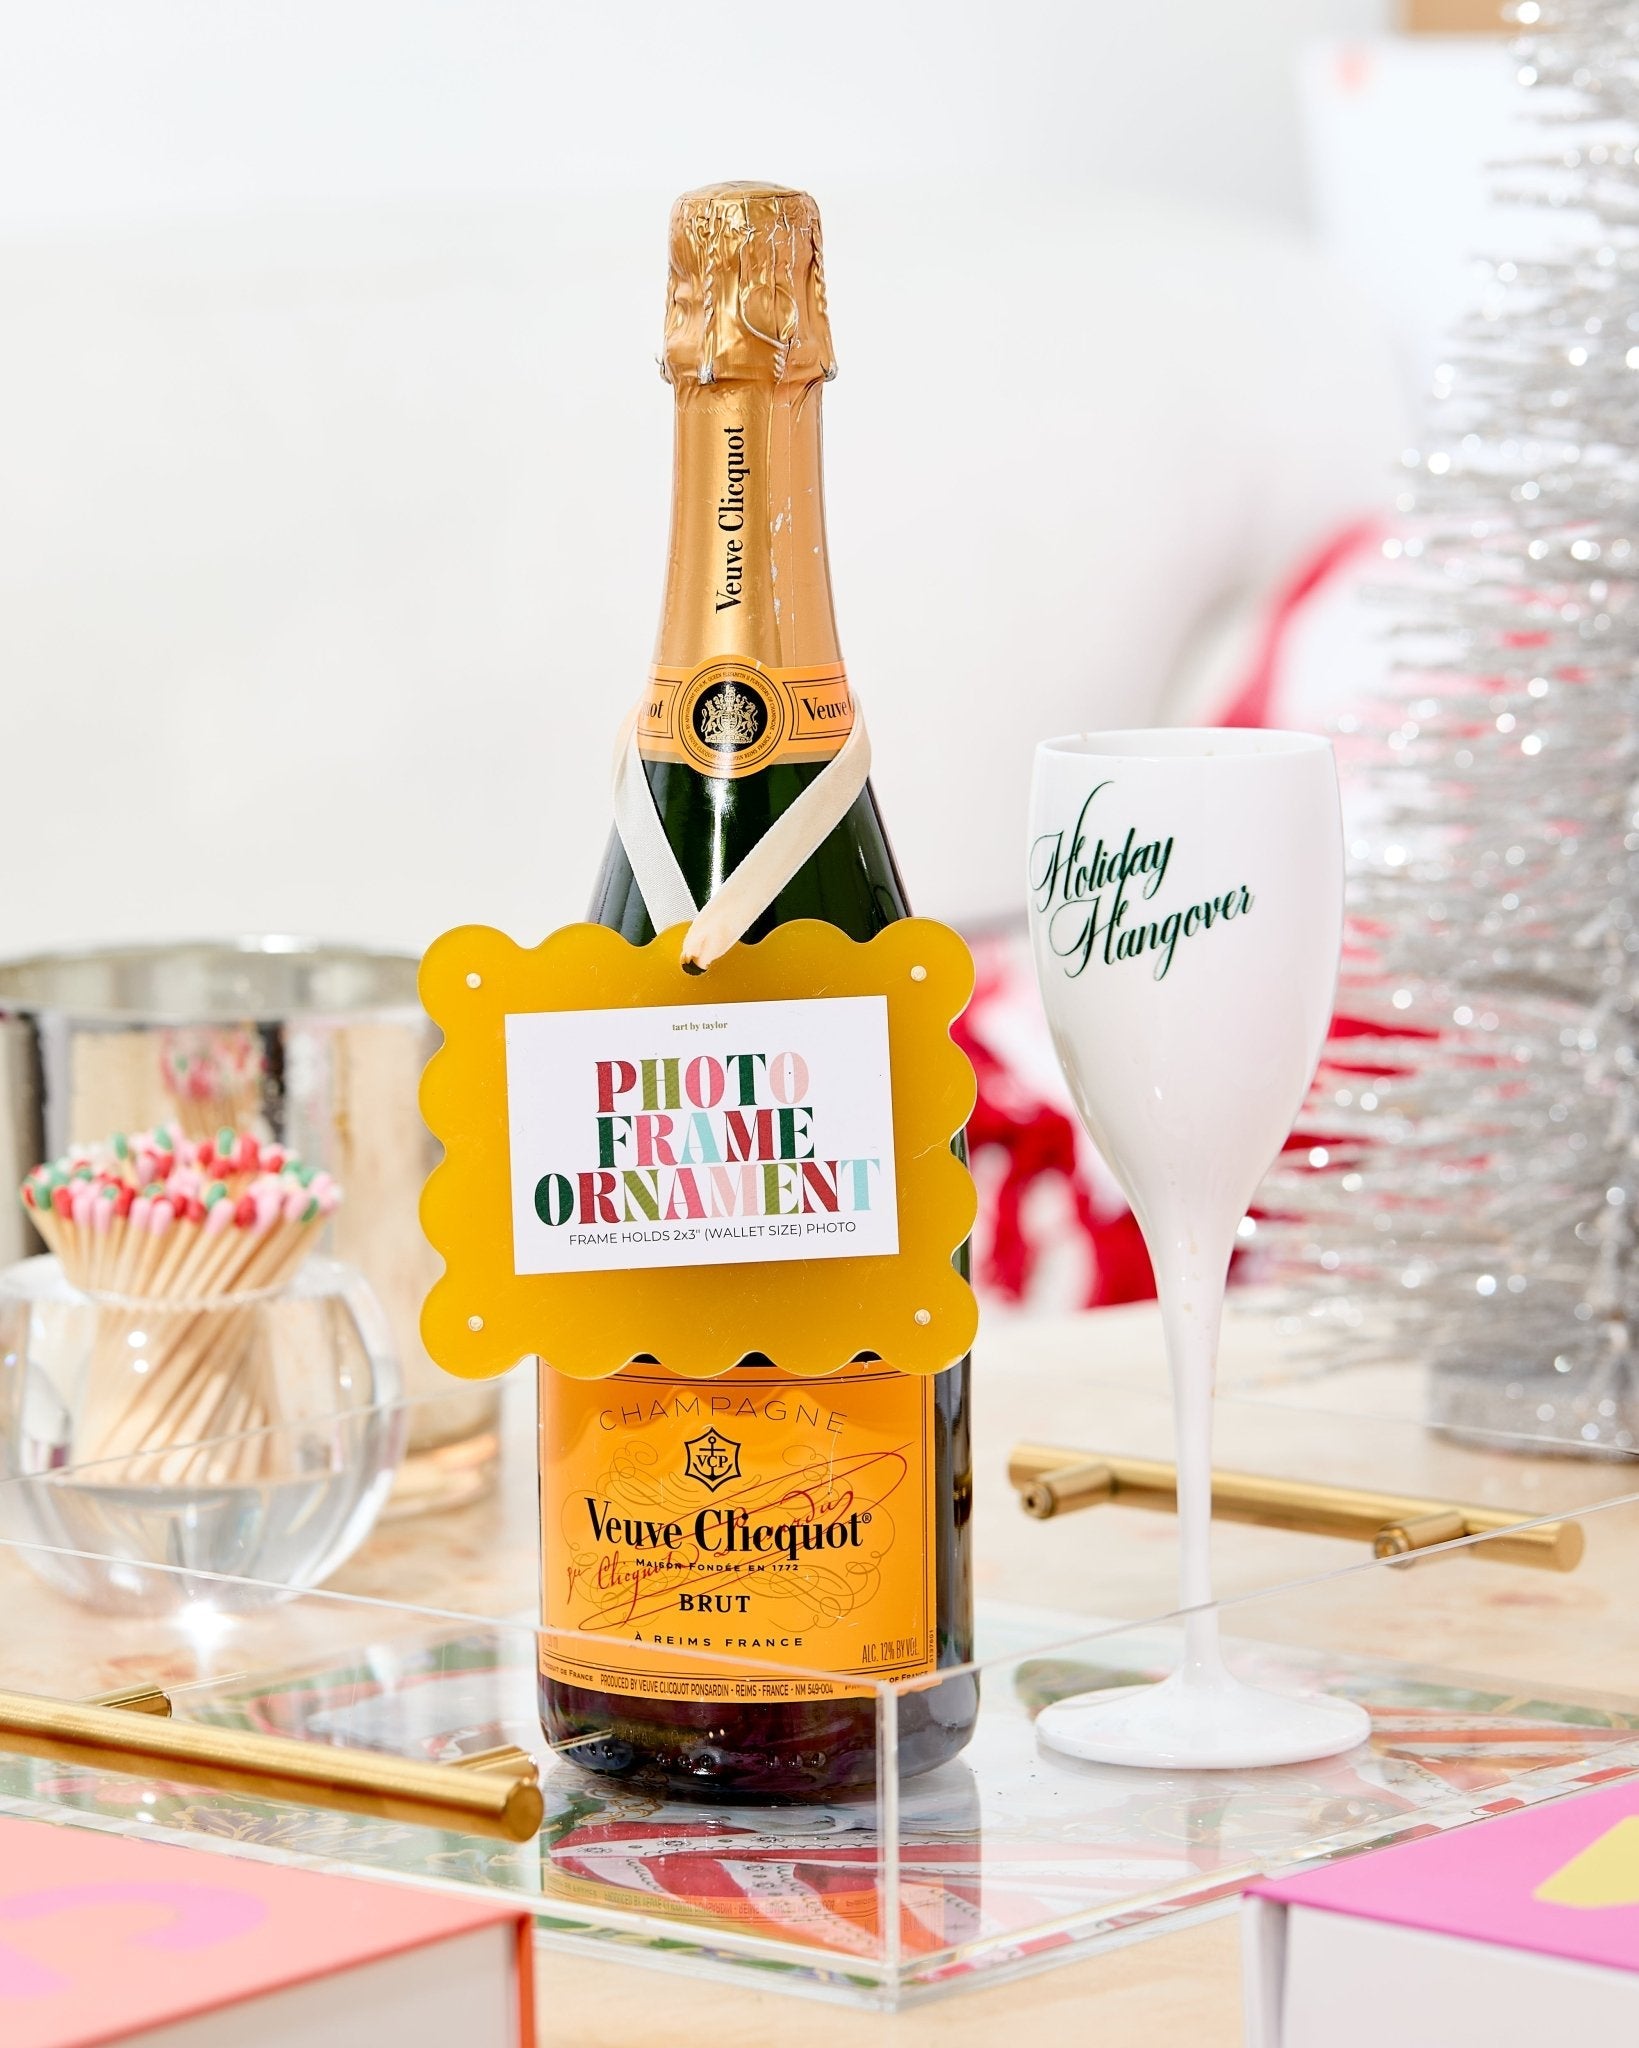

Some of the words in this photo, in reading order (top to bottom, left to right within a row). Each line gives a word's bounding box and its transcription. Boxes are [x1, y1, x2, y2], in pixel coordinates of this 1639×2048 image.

[718, 424, 750, 532] Clicquot
[716, 539, 743, 614] Veuve
[800, 697, 847, 722] Veuve
[1029, 780, 1174, 913] Holiday
[1049, 884, 1255, 981] Hangover
[672, 1023, 688, 1031] tart
[690, 1022, 700, 1032] by
[702, 1020, 728, 1031] taylor
[595, 1051, 809, 1113] PHOTO
[595, 1107, 814, 1168] FRAME
[534, 1158, 880, 1227] ORNAMENT
[569, 1232, 618, 1245] FRAME
[622, 1230, 670, 1243] HOLDS
[674, 1229, 701, 1241] 2x3"
[704, 1225, 765, 1241] (WALLET
[768, 1223, 802, 1238] SIZE)
[806, 1221, 856, 1234] PHOTO
[600, 1396, 848, 1434] CHAMPAGNE
[696, 1454, 728, 1468] VCP
[584, 1497, 683, 1550] Veuve
[636, 1558, 683, 1570] MAISON
[690, 1562, 740, 1572] FONDÉE
[749, 1564, 765, 1572] EN
[679, 1593, 750, 1613] BRUT
[635, 1631, 643, 1642] À
[654, 1635, 711, 1647] REIMS
[725, 1637, 802, 1647] FRANCE
[862, 1644, 879, 1664] ALC.
[881, 1641, 895, 1661] 12%
[896, 1639, 905, 1659] BY
[905, 1637, 920, 1657] VOL.
[568, 1669, 594, 1682] FRANCE
[600, 1674, 629, 1690] PRODUCED
[631, 1678, 638, 1691] BY
[639, 1679, 658, 1693] VEUVE
[660, 1681, 689, 1695] CLICQUOT
[691, 1683, 729, 1697] PONSARDIN
[736, 1684, 757, 1697] REIMS
[762, 1684, 789, 1697] FRANCE
[795, 1684, 806, 1695] NM
